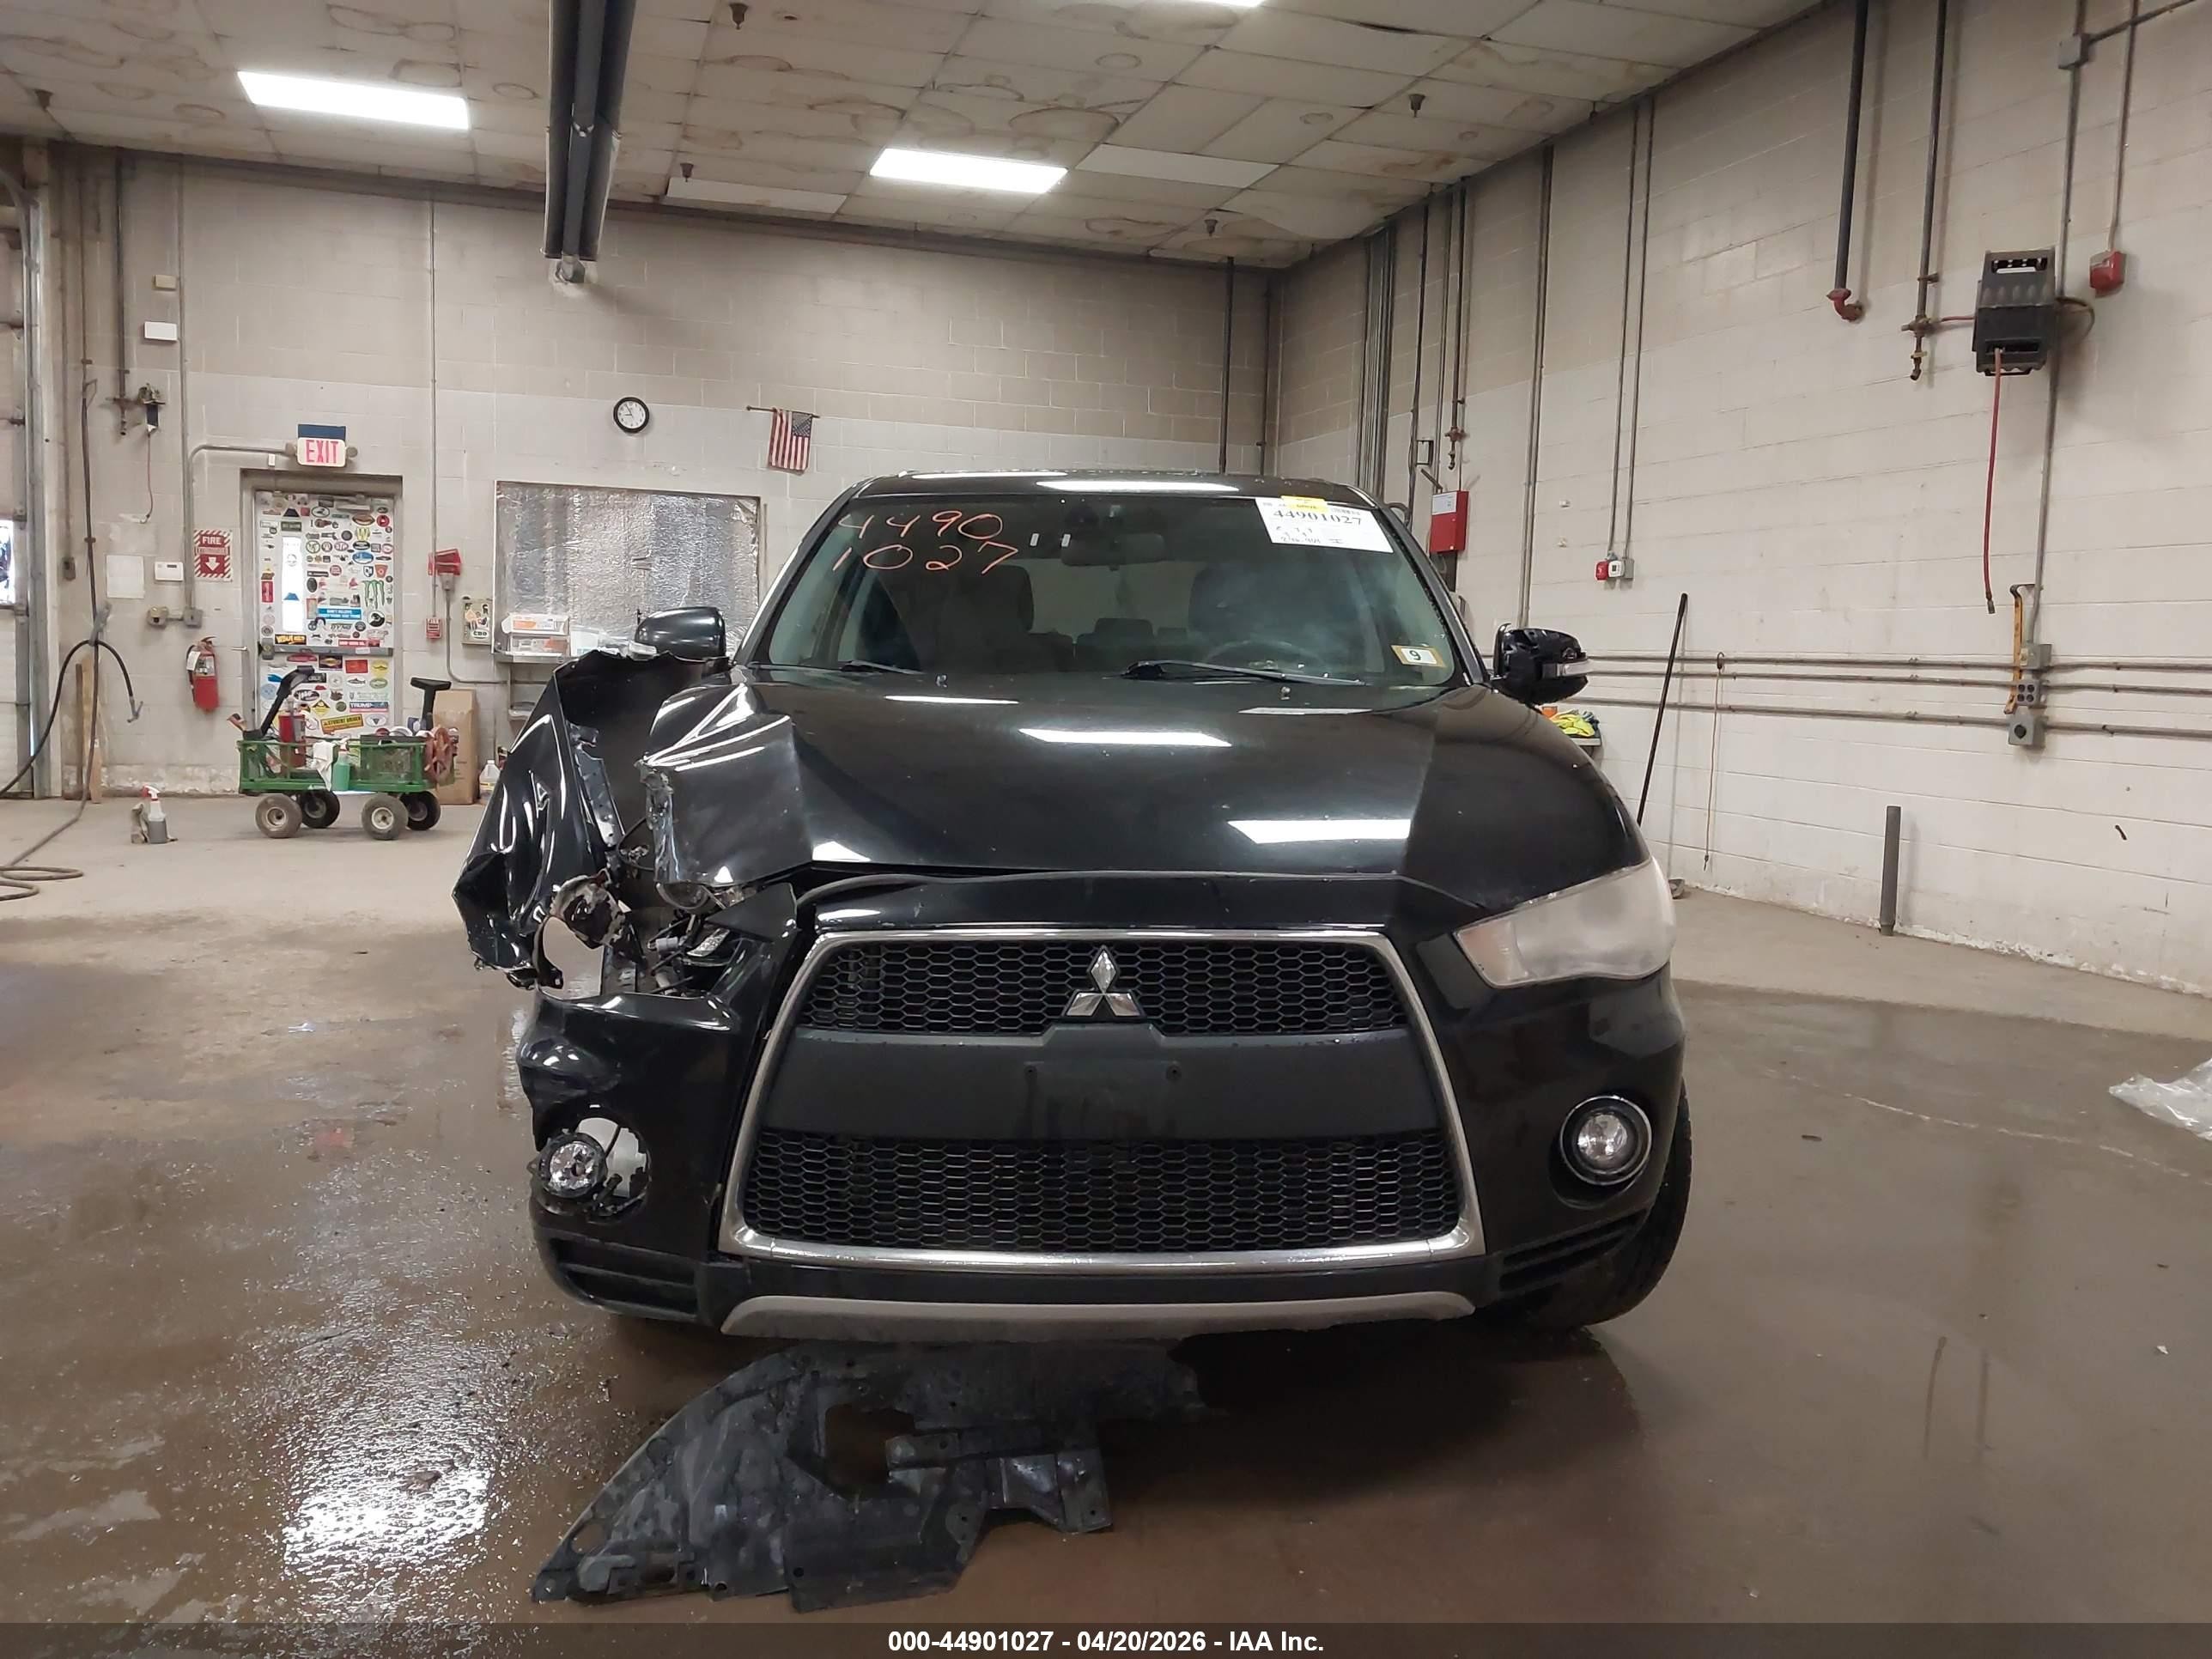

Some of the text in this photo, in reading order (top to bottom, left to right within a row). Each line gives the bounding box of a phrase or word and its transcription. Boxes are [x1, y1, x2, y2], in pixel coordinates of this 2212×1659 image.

[306, 440, 338, 464] EXIT
[837, 510, 1004, 540] 4490
[1273, 509, 1362, 526] 44901027
[202, 536, 222, 545] FIRE
[832, 541, 1019, 574] 1027
[1409, 650, 1421, 661] 9
